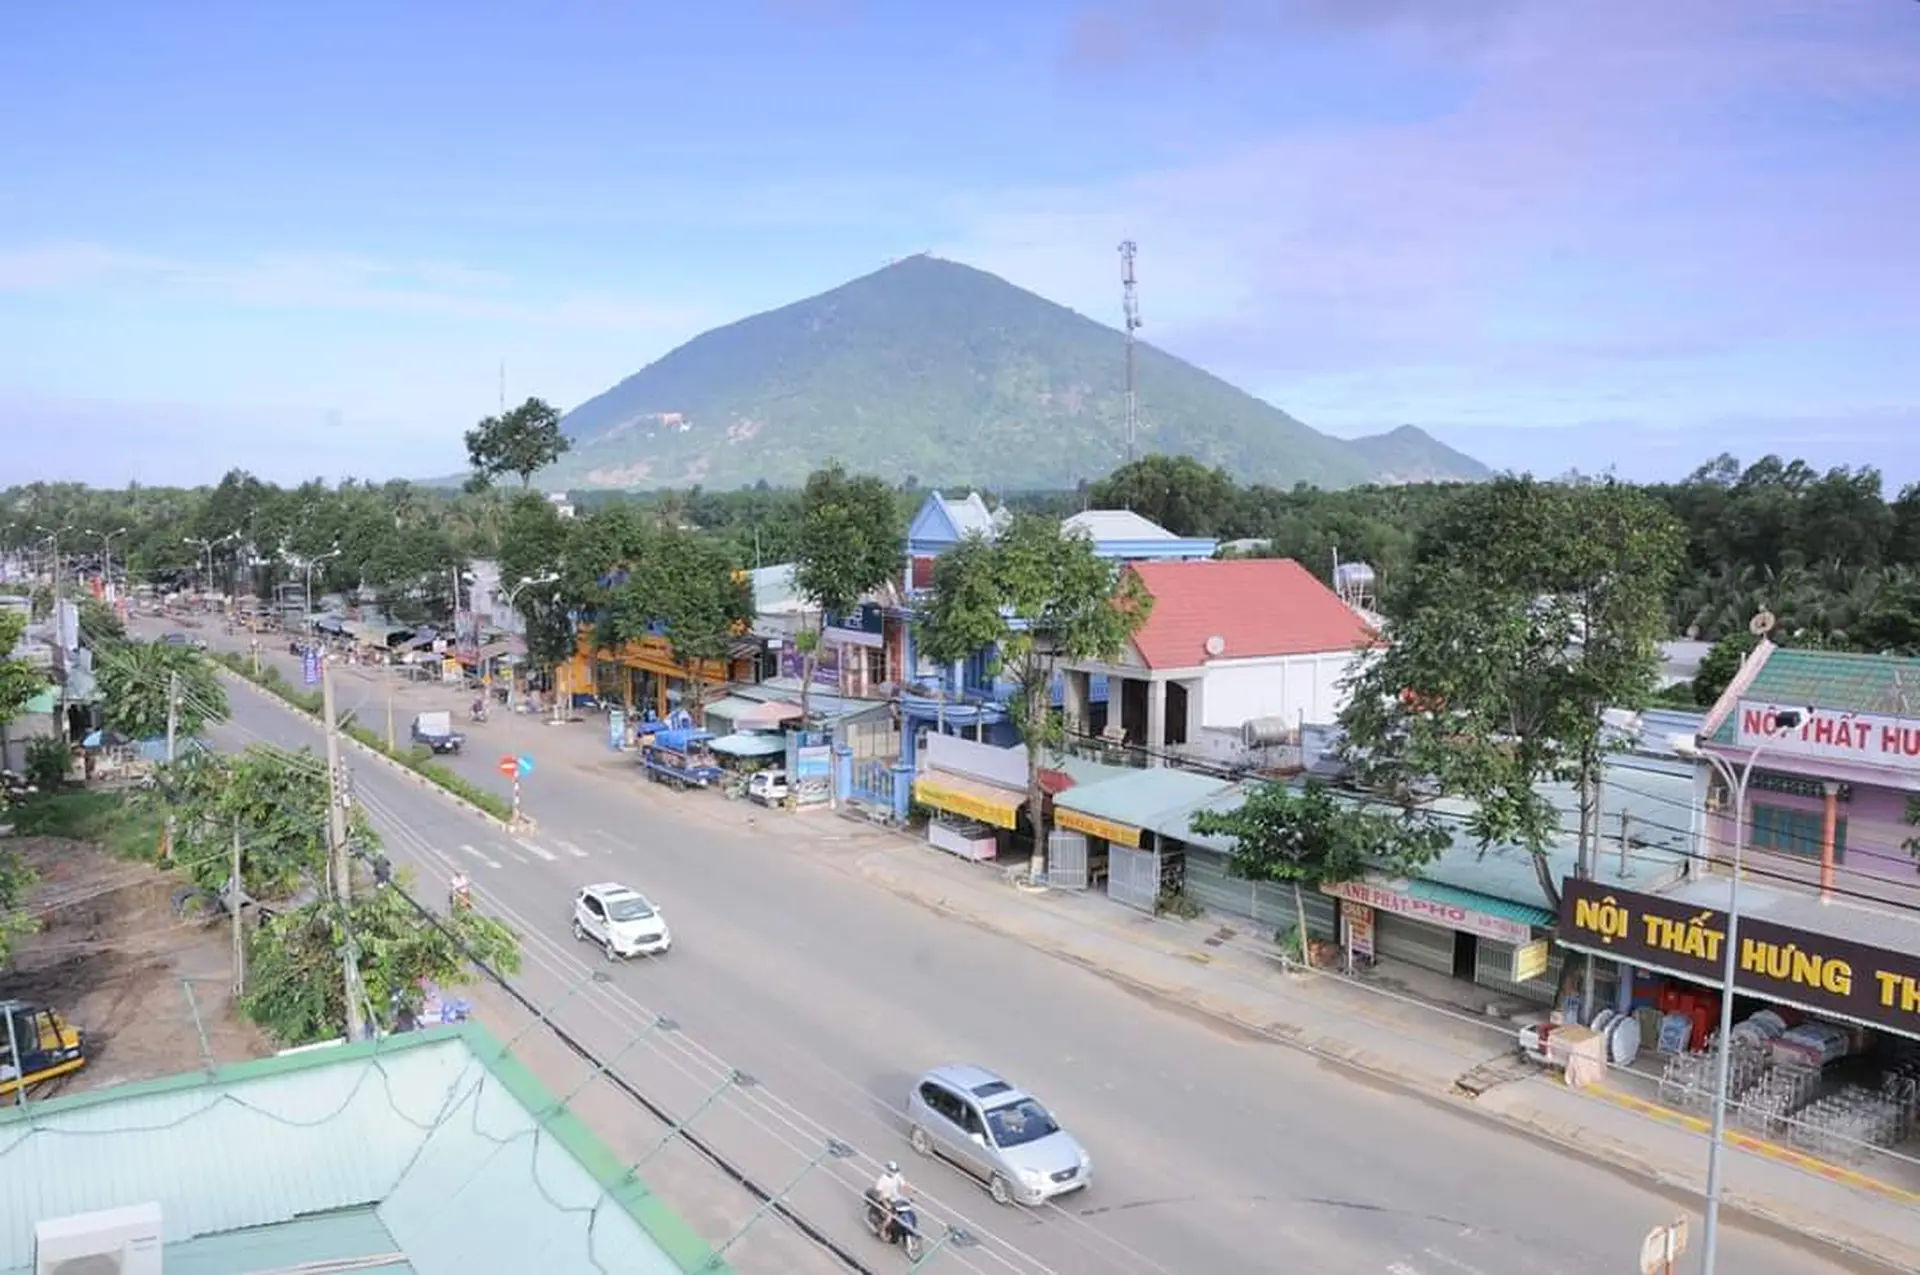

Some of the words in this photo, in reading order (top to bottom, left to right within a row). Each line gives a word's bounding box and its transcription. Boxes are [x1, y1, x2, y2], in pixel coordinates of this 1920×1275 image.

[1575, 895, 1629, 945] NỘI
[1642, 910, 1725, 962] THẤT
[1740, 938, 1853, 997] HƯNG
[1875, 969, 1920, 1013] TH
